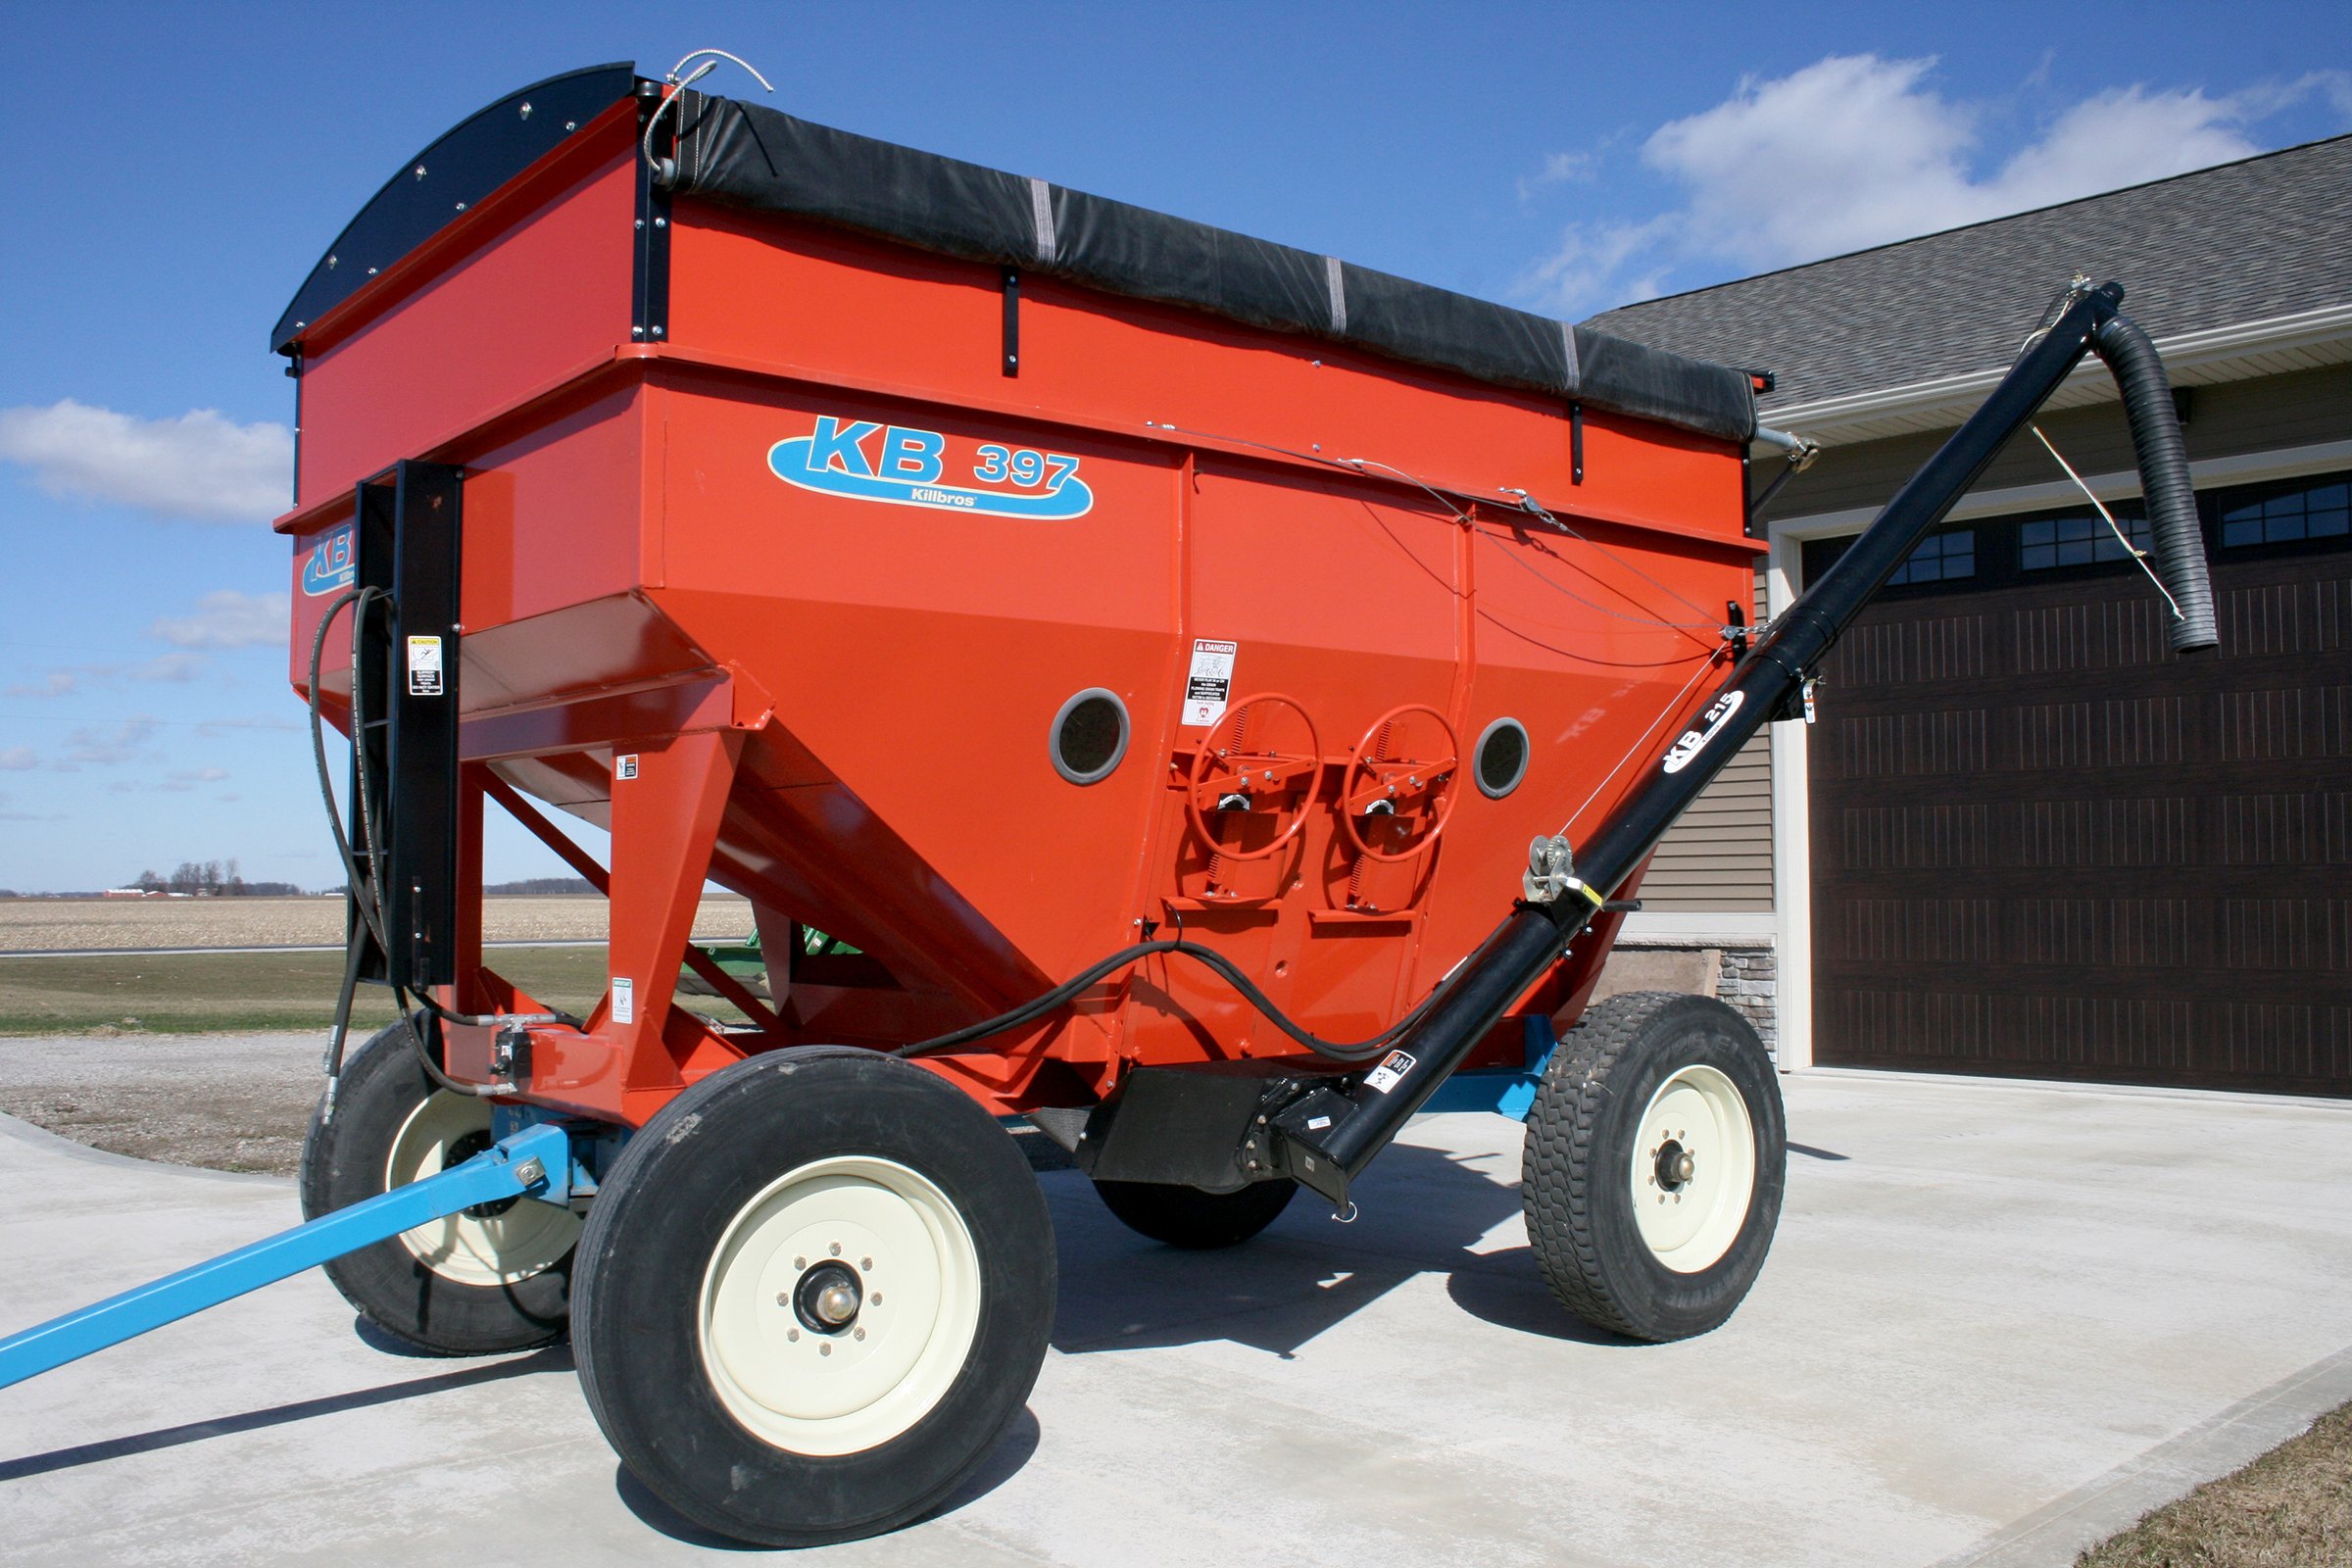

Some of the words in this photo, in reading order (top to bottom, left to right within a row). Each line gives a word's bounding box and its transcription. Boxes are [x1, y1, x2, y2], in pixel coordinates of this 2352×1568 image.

[807, 416, 945, 483] KB
[974, 445, 1079, 490] 397
[911, 488, 975, 507] Killbros
[311, 524, 353, 582] KB
[1204, 643, 1234, 653] DANGER
[1663, 730, 1702, 764] KB
[1704, 693, 1734, 722] 215
